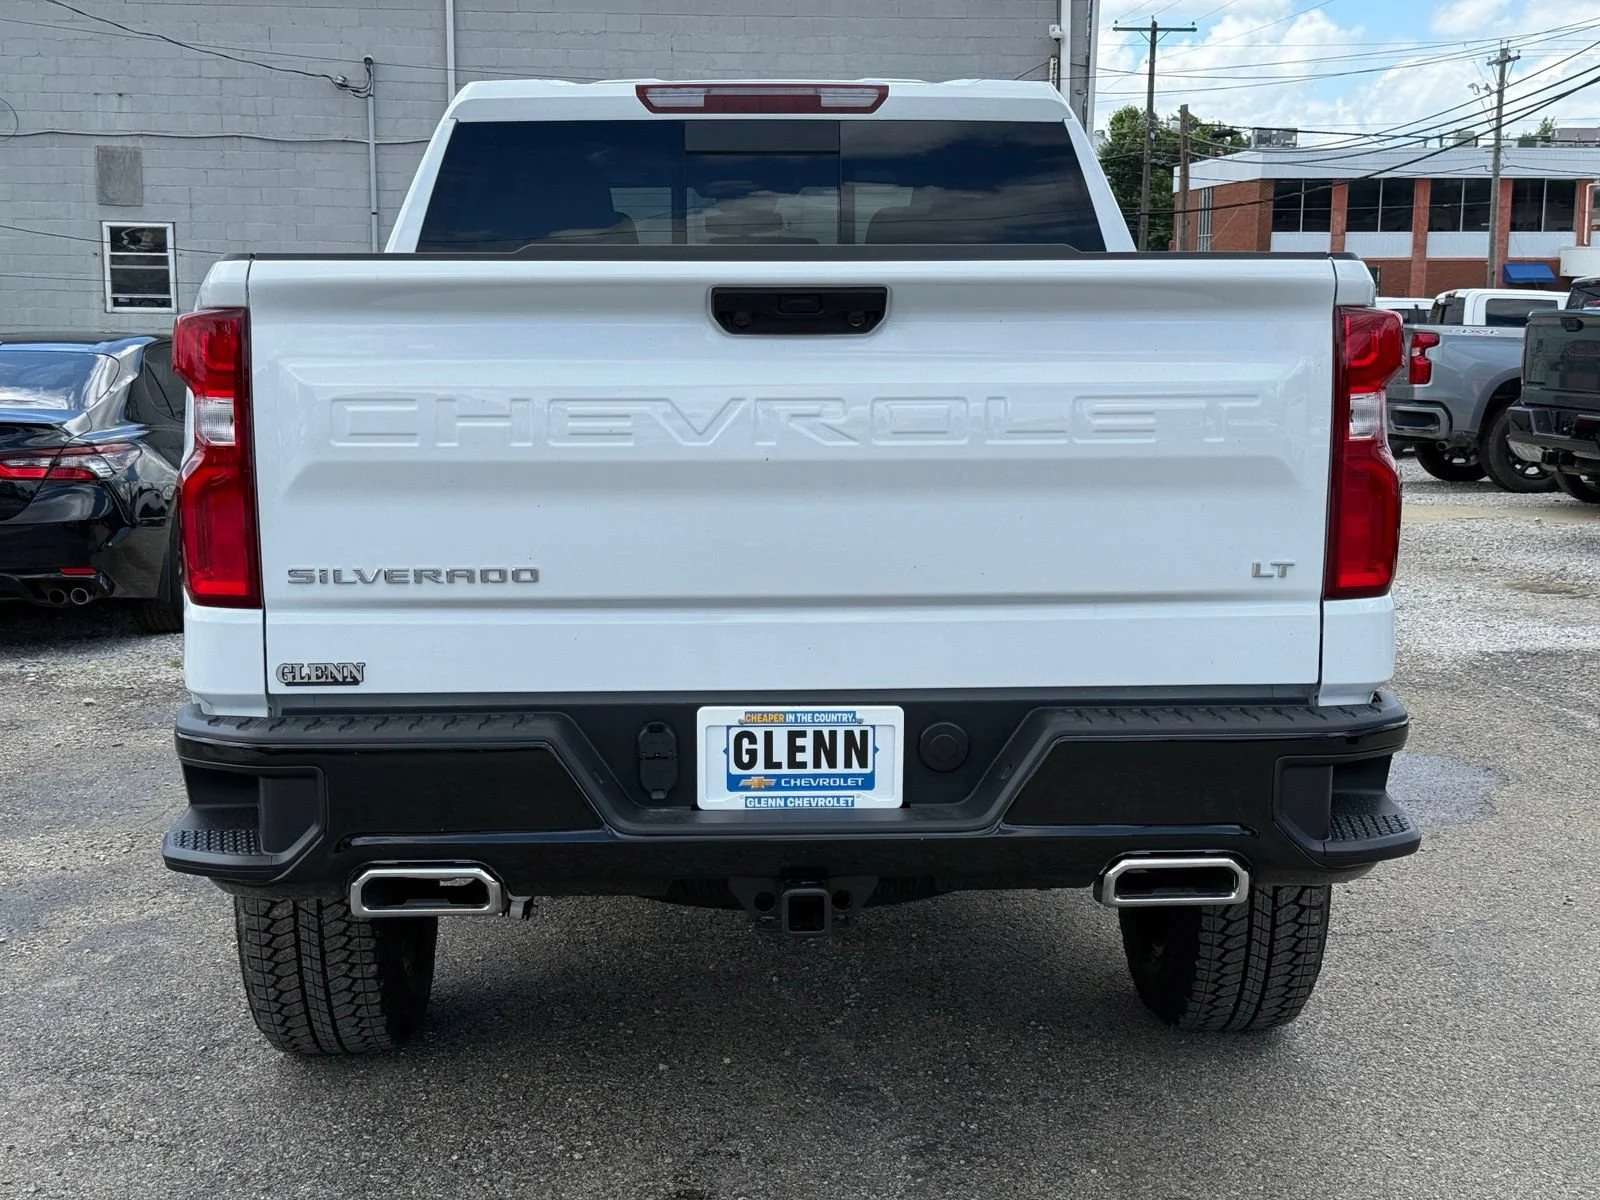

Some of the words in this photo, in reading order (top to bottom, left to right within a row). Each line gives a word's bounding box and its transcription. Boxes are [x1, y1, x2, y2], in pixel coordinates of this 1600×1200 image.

[329, 394, 1261, 447] CHEVROLET
[287, 568, 540, 584] SILVERADO
[1252, 561, 1296, 578] LT
[276, 662, 366, 686] GLENN
[745, 712, 784, 723] CHEAPER
[785, 712, 795, 723] IN
[797, 712, 813, 723] THE
[813, 712, 856, 723] COUNTRY.
[733, 729, 869, 770] GLENN
[781, 777, 864, 787] CHEVROLET
[746, 797, 785, 807] GLENN
[787, 797, 854, 807] CHEVROLET
